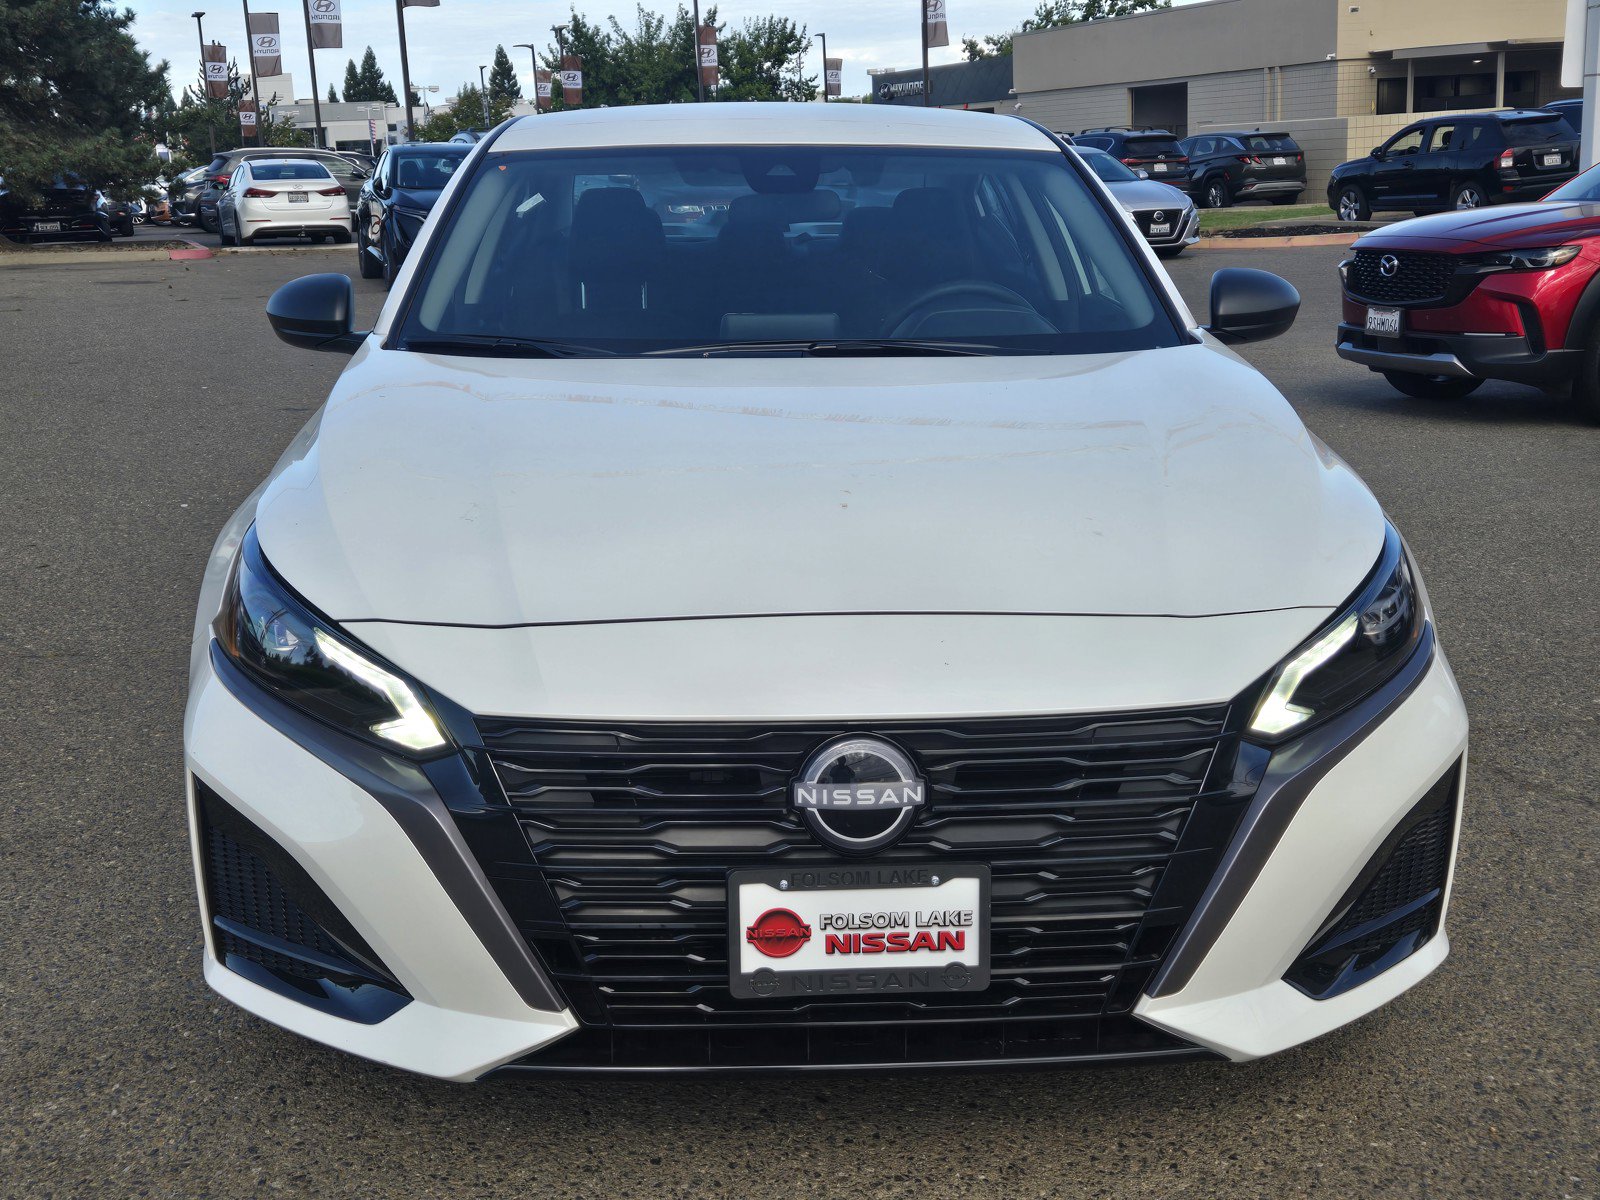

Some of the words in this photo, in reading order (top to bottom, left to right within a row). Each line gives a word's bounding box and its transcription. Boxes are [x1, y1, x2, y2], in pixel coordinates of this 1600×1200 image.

[797, 786, 922, 805] NISSAN
[791, 871, 870, 888] FOLSOM
[878, 869, 929, 885] LAKE
[819, 911, 910, 931] FOLSOM
[915, 909, 974, 928] LAKE
[745, 927, 812, 939] NISSAN
[825, 931, 966, 955] NISSAN
[791, 971, 930, 992] NISSAN
